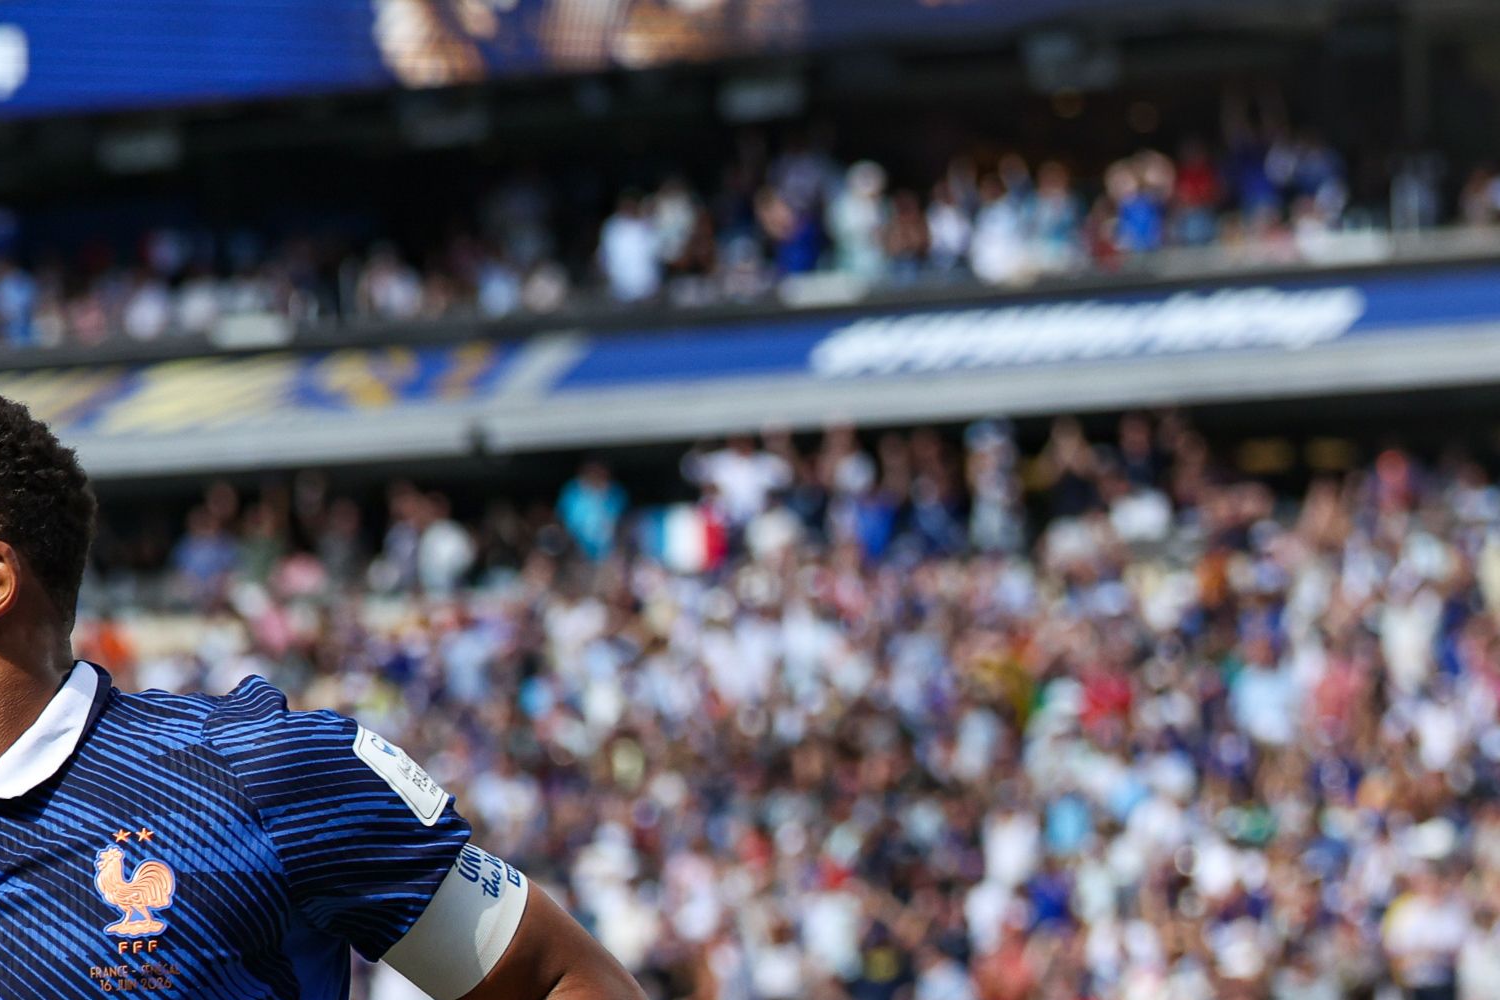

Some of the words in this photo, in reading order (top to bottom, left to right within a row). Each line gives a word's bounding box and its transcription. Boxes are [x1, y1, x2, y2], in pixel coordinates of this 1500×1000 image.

[481, 868, 502, 898] the
[90, 965, 128, 979] FRANCE
[100, 979, 112, 992] 16
[140, 977, 172, 991] 2026
